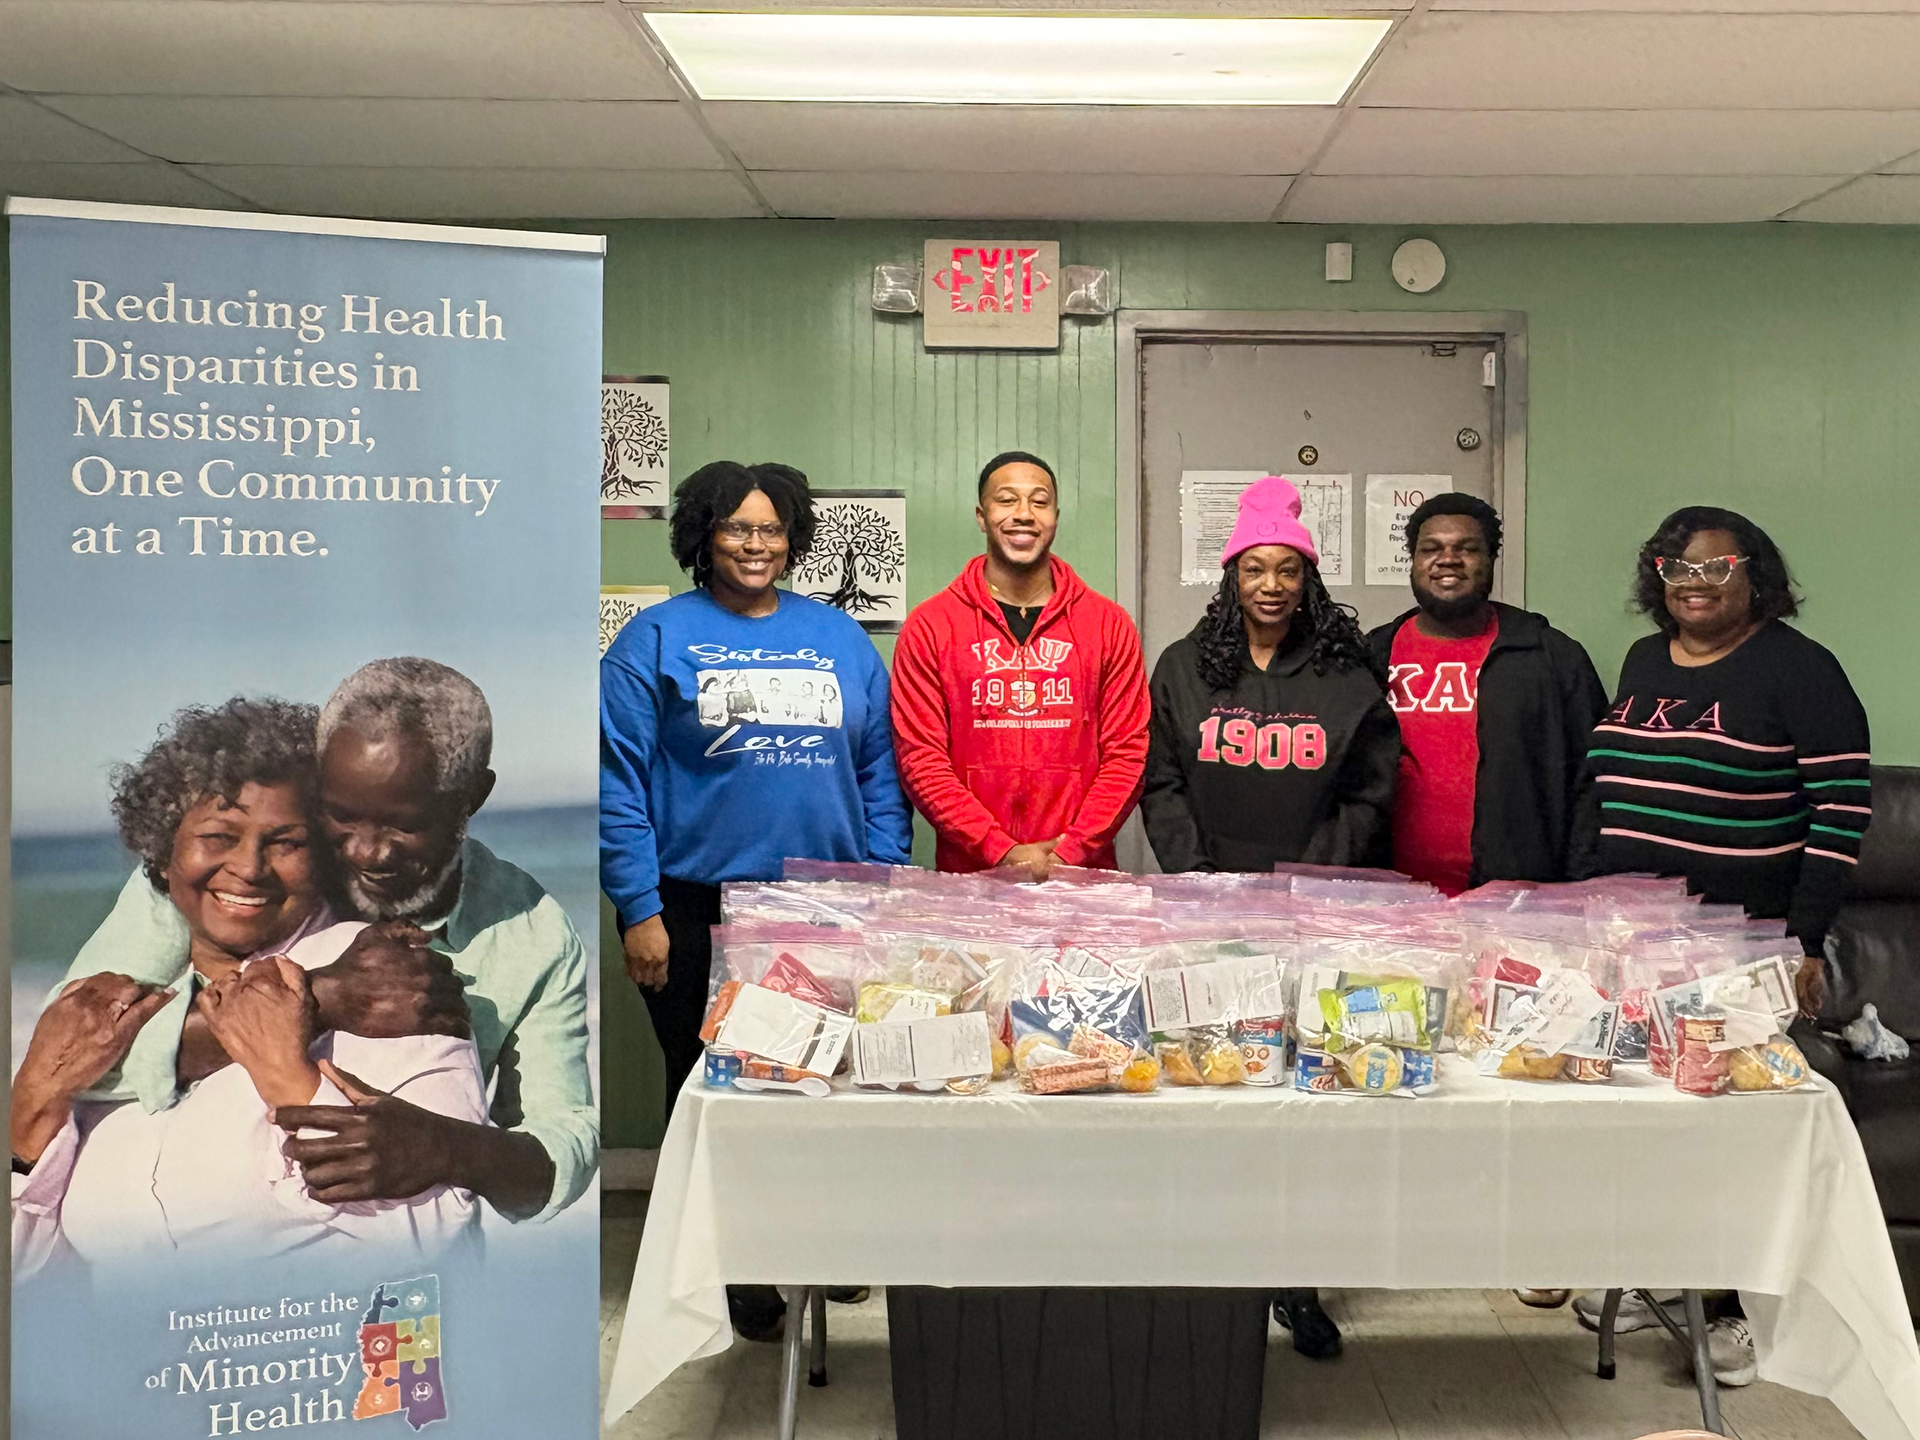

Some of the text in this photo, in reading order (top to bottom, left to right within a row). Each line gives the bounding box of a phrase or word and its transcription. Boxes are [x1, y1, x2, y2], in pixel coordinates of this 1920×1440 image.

[950, 247, 1040, 313] EXIT
[73, 280, 506, 343] Reducing Health
[72, 338, 420, 396] Disparities in
[73, 397, 376, 458] Mississippi,
[71, 455, 501, 517] One Community
[1393, 490, 1426, 507] NO
[71, 516, 329, 556] at a Time.
[1043, 677, 1074, 706] 11
[703, 724, 825, 758] Love
[1197, 716, 1327, 770] 1908
[168, 1292, 359, 1331] Institute for the
[186, 1322, 342, 1354] Advancement
[145, 1348, 356, 1395] of Minority
[208, 1388, 347, 1437] Health
